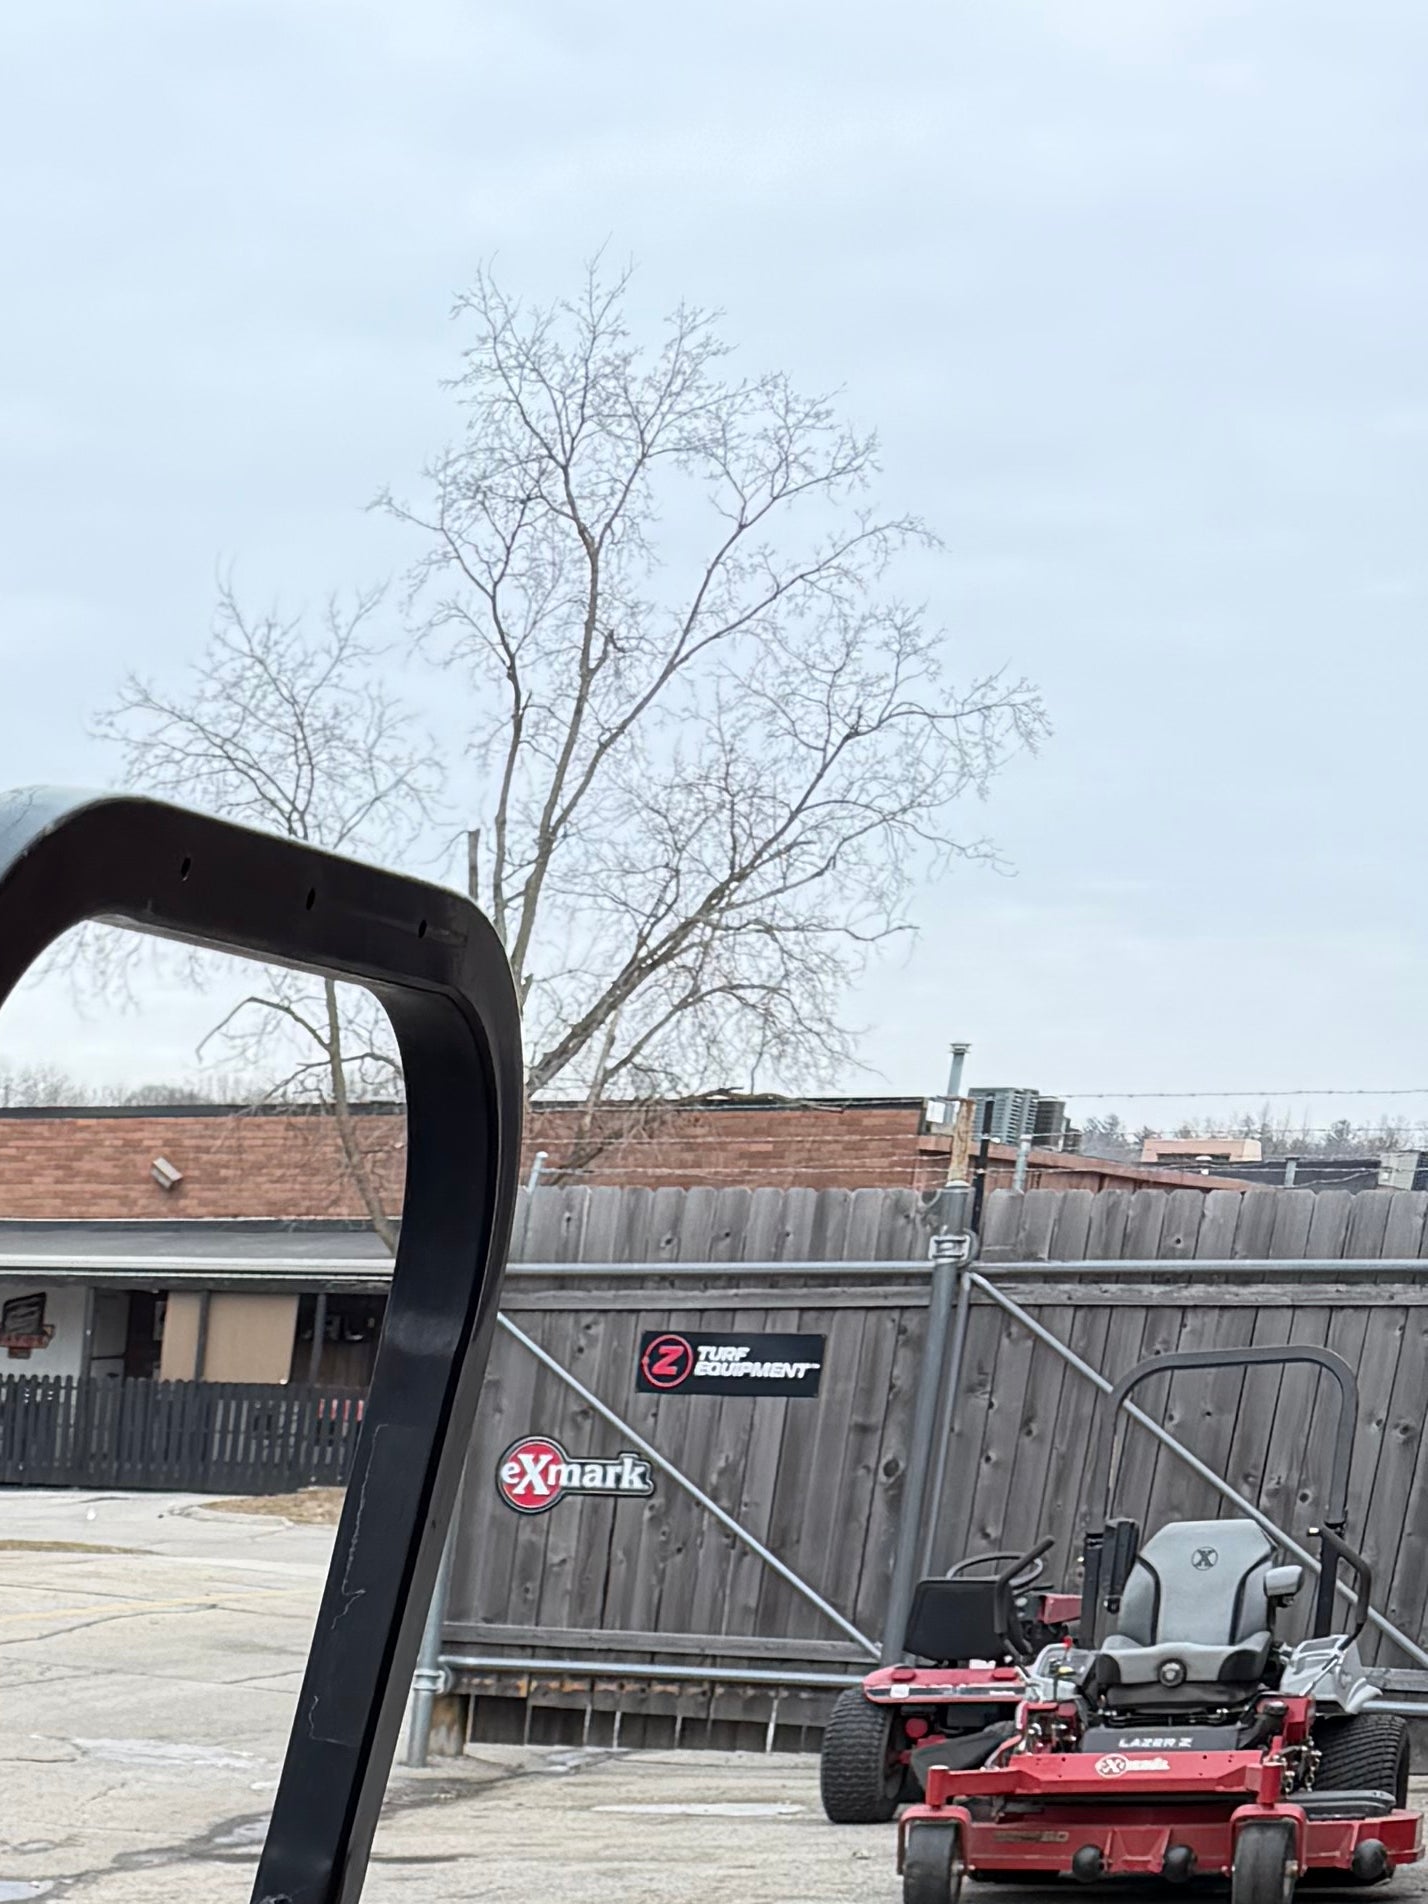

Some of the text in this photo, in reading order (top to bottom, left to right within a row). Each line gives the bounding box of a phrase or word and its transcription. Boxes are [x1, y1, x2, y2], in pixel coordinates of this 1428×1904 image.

[652, 1345, 684, 1375] Z
[696, 1345, 750, 1361] TURF
[694, 1361, 808, 1379] EQUIPMENT
[501, 1453, 649, 1496] eXmark
[1118, 1737, 1177, 1748] LAZER
